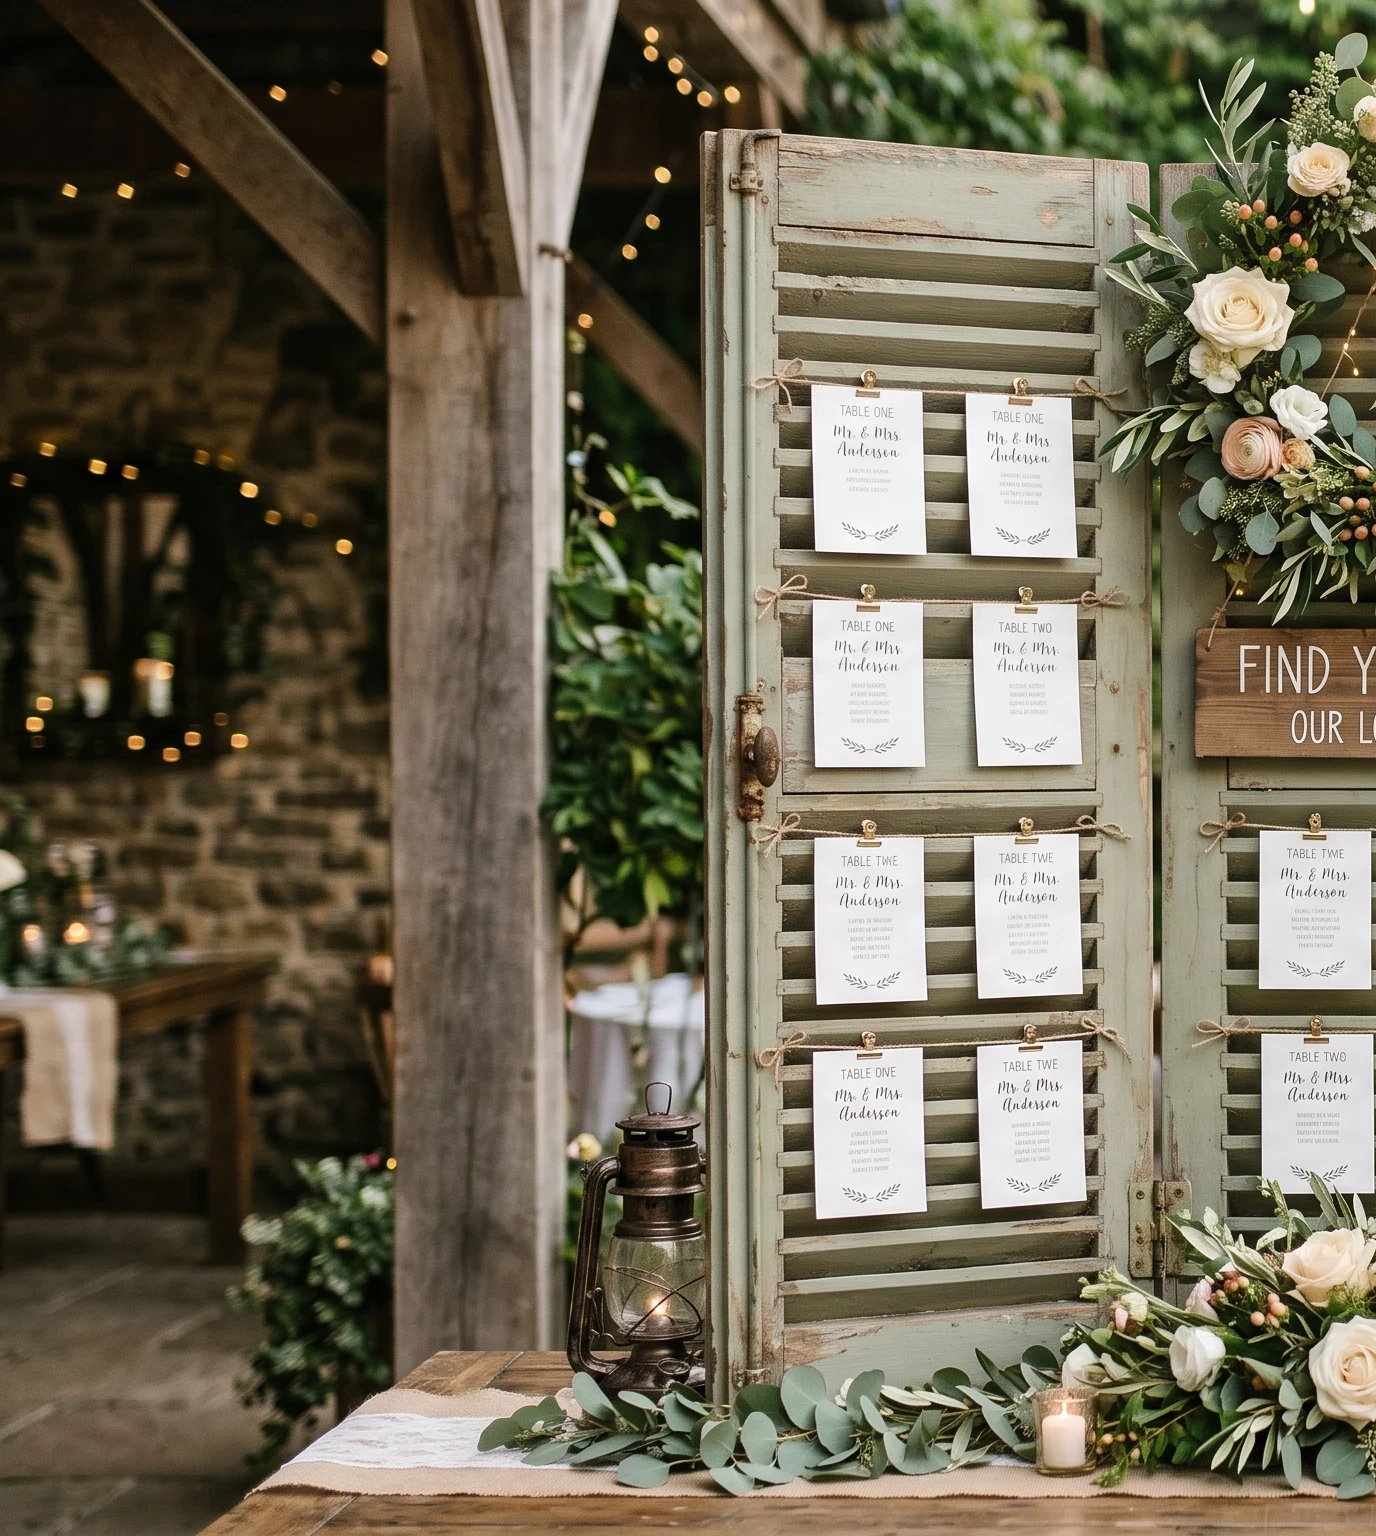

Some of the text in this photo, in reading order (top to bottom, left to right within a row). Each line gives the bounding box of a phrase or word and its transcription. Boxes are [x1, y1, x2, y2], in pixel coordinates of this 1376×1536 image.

[840, 405, 894, 418] TABLE ONE
[992, 411, 1044, 424] TABLE ONE
[841, 620, 895, 632] TABLE ONE
[999, 622, 1052, 633] TABLE TWO
[1239, 645, 1330, 694] FIND
[1291, 710, 1343, 744] OUR
[999, 853, 1028, 864] TABLE
[1286, 848, 1316, 859] TABLE
[841, 856, 871, 867] TABLE
[1289, 1052, 1346, 1062] TABLE TWO
[1003, 1059, 1058, 1072] TABLE TWE
[841, 1066, 896, 1080] TABLE ONE
